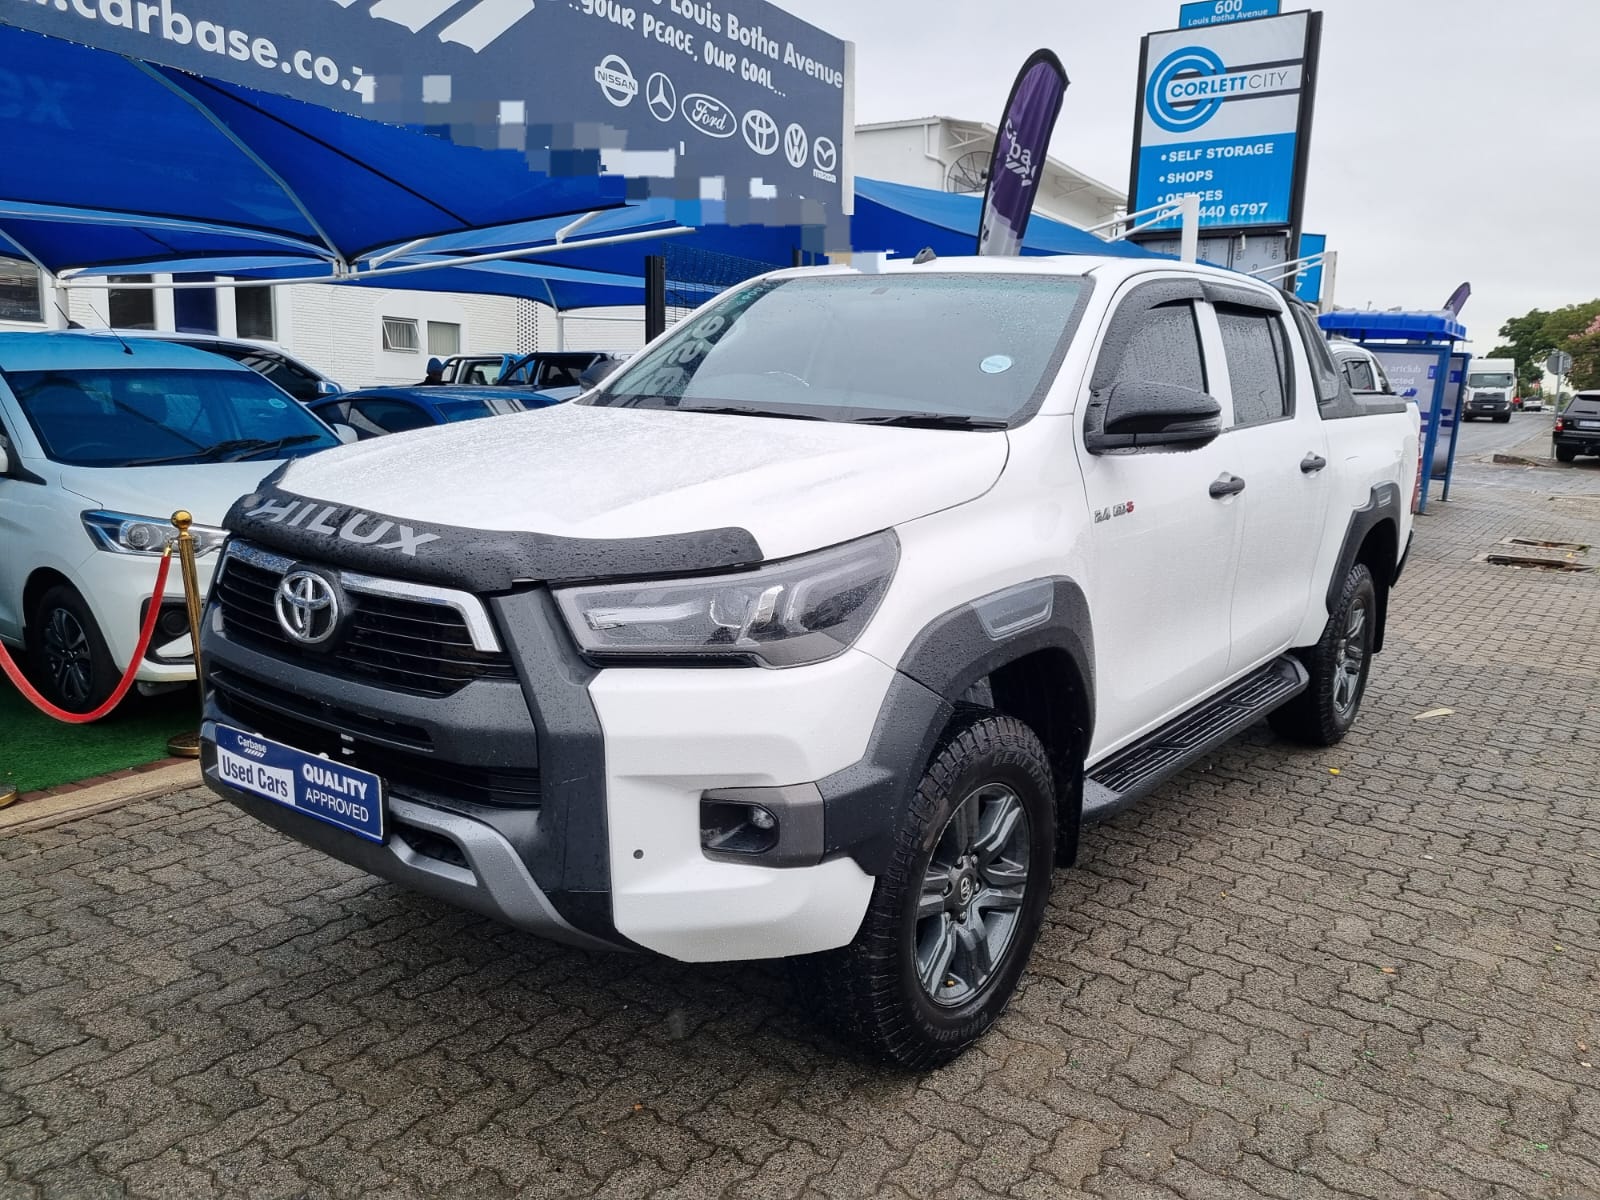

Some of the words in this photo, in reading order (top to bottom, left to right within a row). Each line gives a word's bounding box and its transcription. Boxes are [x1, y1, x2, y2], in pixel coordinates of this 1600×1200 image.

[1188, 17, 1209, 26] Louis
[1211, 14, 1235, 23] Botha
[1237, 9, 1269, 19] Avenue
[1214, 0, 1243, 14] 600
[643, 12, 698, 62] PEACE,
[704, 41, 736, 73] OUR
[670, 0, 721, 33] Louis
[727, 13, 779, 60] Botha
[783, 42, 843, 88] Avenue
[598, 70, 636, 92] NISSAN
[692, 99, 728, 131] Ford
[1169, 149, 1203, 163] SELF
[1206, 142, 1274, 159] STORAGE
[1167, 169, 1213, 184] SHOPS
[1230, 202, 1268, 217] 6797
[245, 499, 441, 556] HILUX
[237, 735, 267, 753] Carbase
[222, 754, 254, 785] Used
[257, 767, 289, 798] Cars
[303, 762, 368, 800] QUALITY
[305, 787, 369, 822] APPROVED
